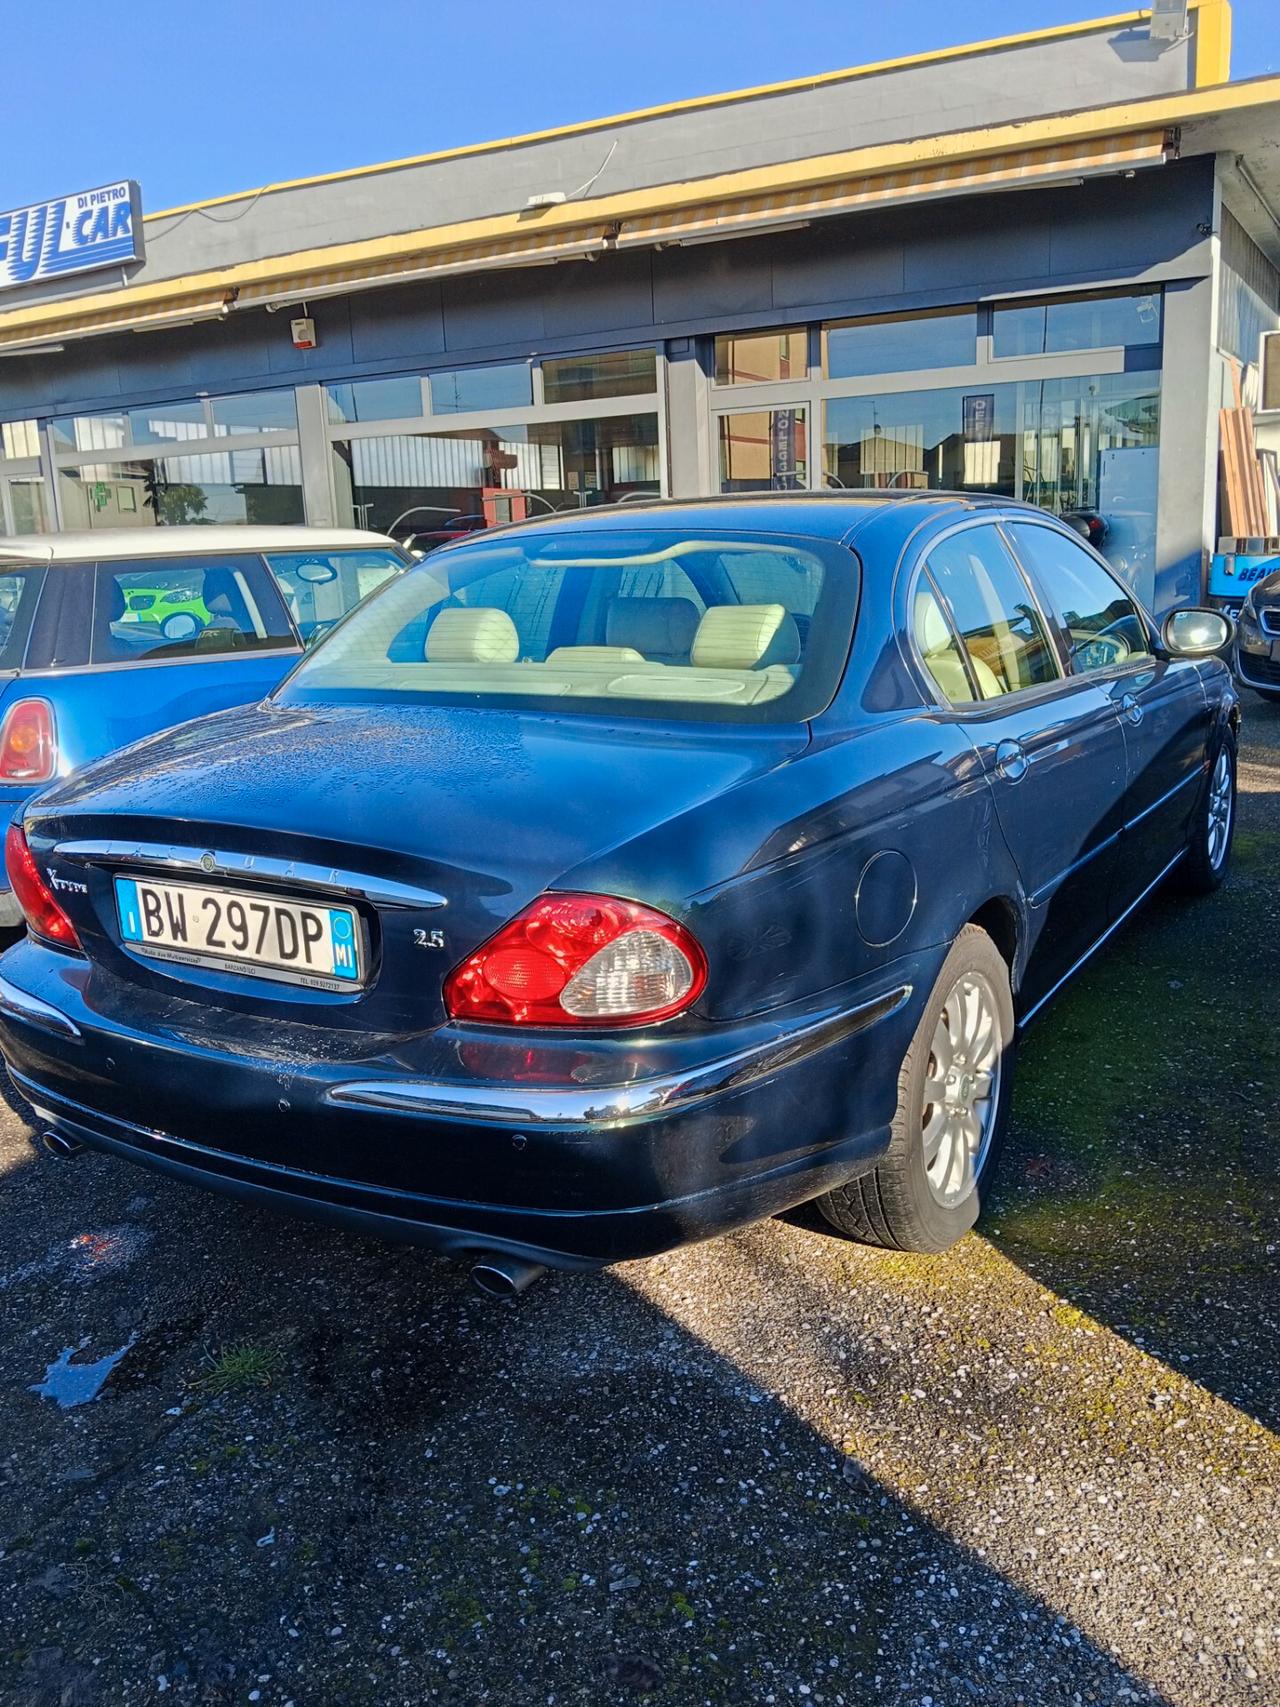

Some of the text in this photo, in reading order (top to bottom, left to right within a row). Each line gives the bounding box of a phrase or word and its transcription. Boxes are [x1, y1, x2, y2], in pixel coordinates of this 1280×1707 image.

[77, 186, 126, 209] DI PIETRO
[141, 888, 323, 964] BW 297DP
[333, 943, 353, 969] MI
